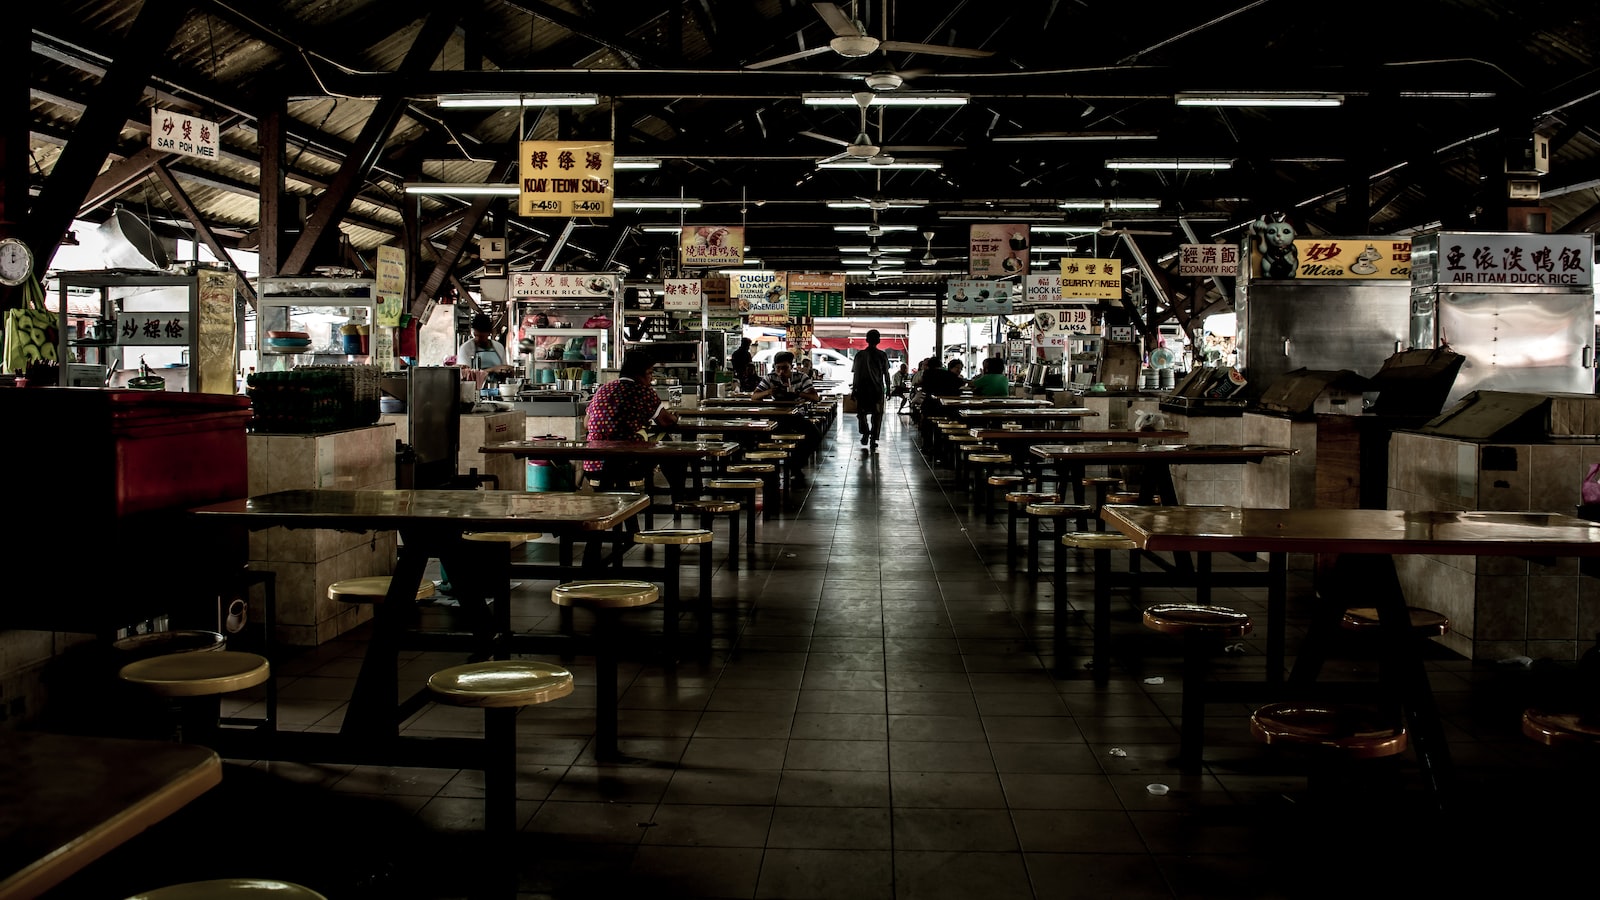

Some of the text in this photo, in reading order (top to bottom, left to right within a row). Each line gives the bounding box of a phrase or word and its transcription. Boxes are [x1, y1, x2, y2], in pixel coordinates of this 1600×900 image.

[157, 138, 214, 157] SAR POH MEE
[524, 178, 609, 193] KOAY TEOW SOUP
[1183, 247, 1236, 263] 經濟飯
[1181, 265, 1237, 273] ECONOMY RICE
[1301, 264, 1344, 275] Miao
[1062, 279, 1120, 288] CURRY MEE
[1453, 272, 1578, 284] AIR ITAM DUCK RICE
[750, 303, 785, 311] PASEMBUR
[1059, 311, 1087, 323] 叻沙
[122, 318, 185, 338] 炒粿條
